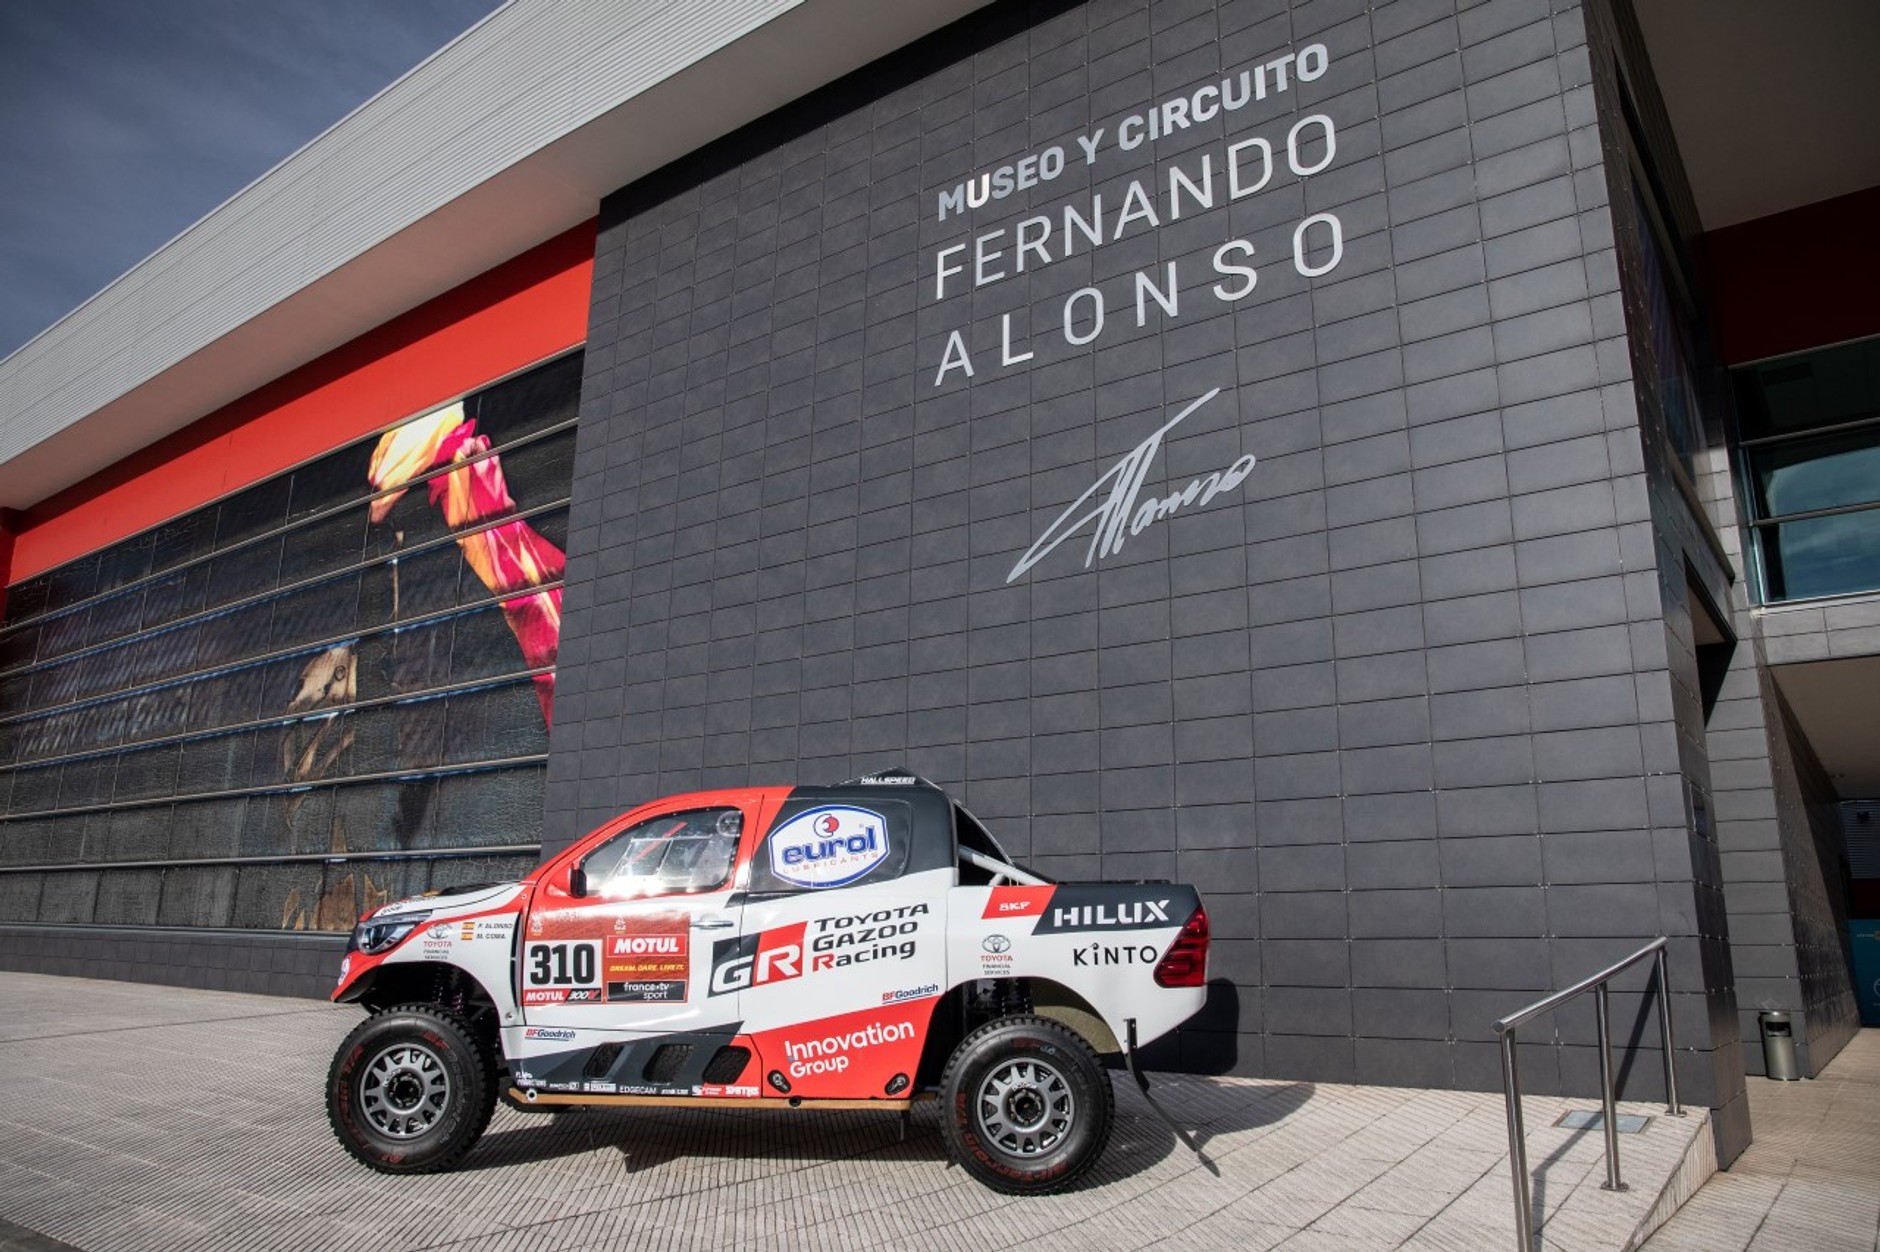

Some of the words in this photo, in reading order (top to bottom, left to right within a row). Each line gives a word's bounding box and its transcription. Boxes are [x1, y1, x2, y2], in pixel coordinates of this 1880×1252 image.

[938, 147, 1064, 222] MUSEO
[1077, 128, 1105, 165] Y
[1118, 43, 1329, 152] CIRCUITO
[935, 114, 1336, 300] FERNANDO
[934, 213, 1343, 387] ALONSO
[782, 825, 877, 865] eurol
[814, 903, 929, 932] TOYOTA
[999, 901, 1030, 911] SKF
[1053, 899, 1170, 927] HILUX
[614, 937, 679, 954] MOTUL
[812, 921, 918, 952] GAZOO
[530, 944, 595, 985] 310
[712, 944, 801, 993] GR
[812, 940, 917, 972] Racing
[526, 990, 564, 1001] MOTUL
[643, 991, 668, 1001] sport
[882, 983, 939, 1001] BFGoodrich
[525, 1028, 576, 1039] BFGoodrich
[784, 1021, 915, 1061] Innovation
[789, 1055, 849, 1078] Group
